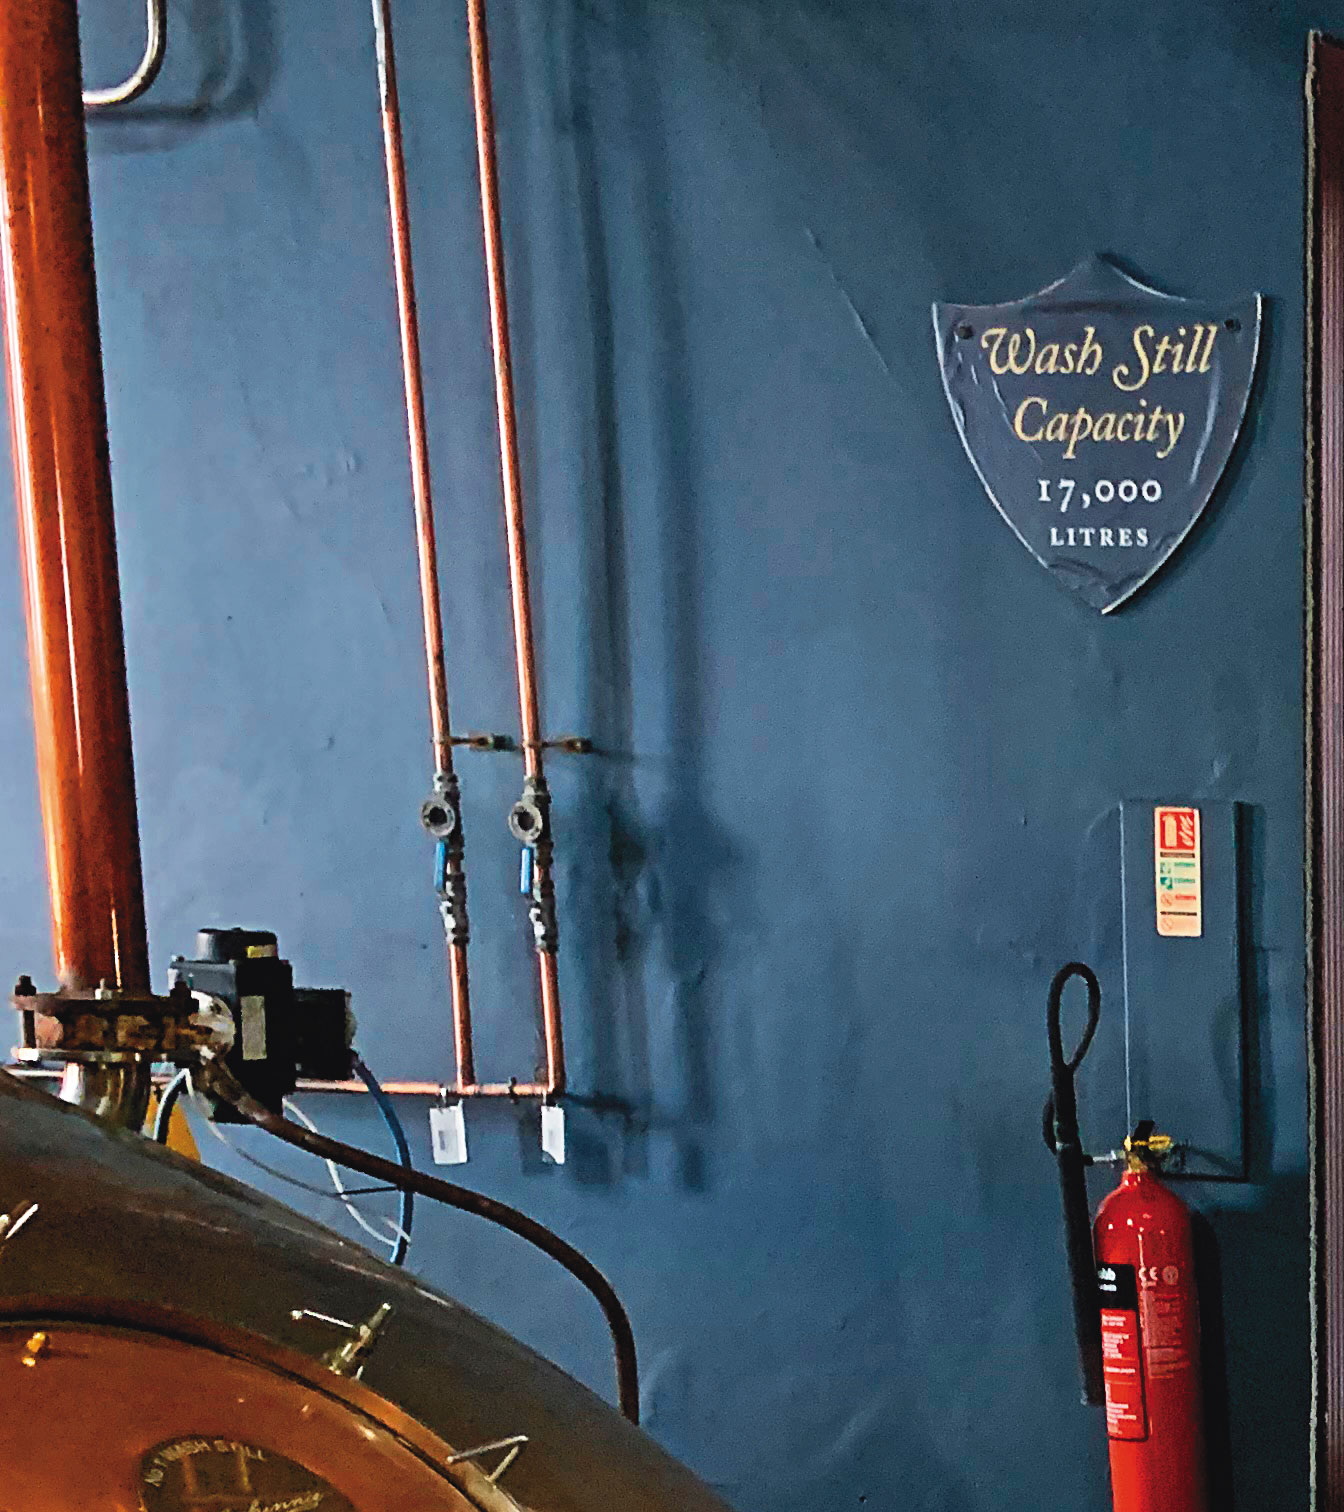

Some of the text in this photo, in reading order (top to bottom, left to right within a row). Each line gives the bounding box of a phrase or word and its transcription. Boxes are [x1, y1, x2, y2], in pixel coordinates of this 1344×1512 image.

[980, 323, 1219, 391] Wash Still
[1013, 396, 1185, 460] Capacity
[1037, 478, 1163, 513] 17,000
[1049, 527, 1149, 548] LITRES
